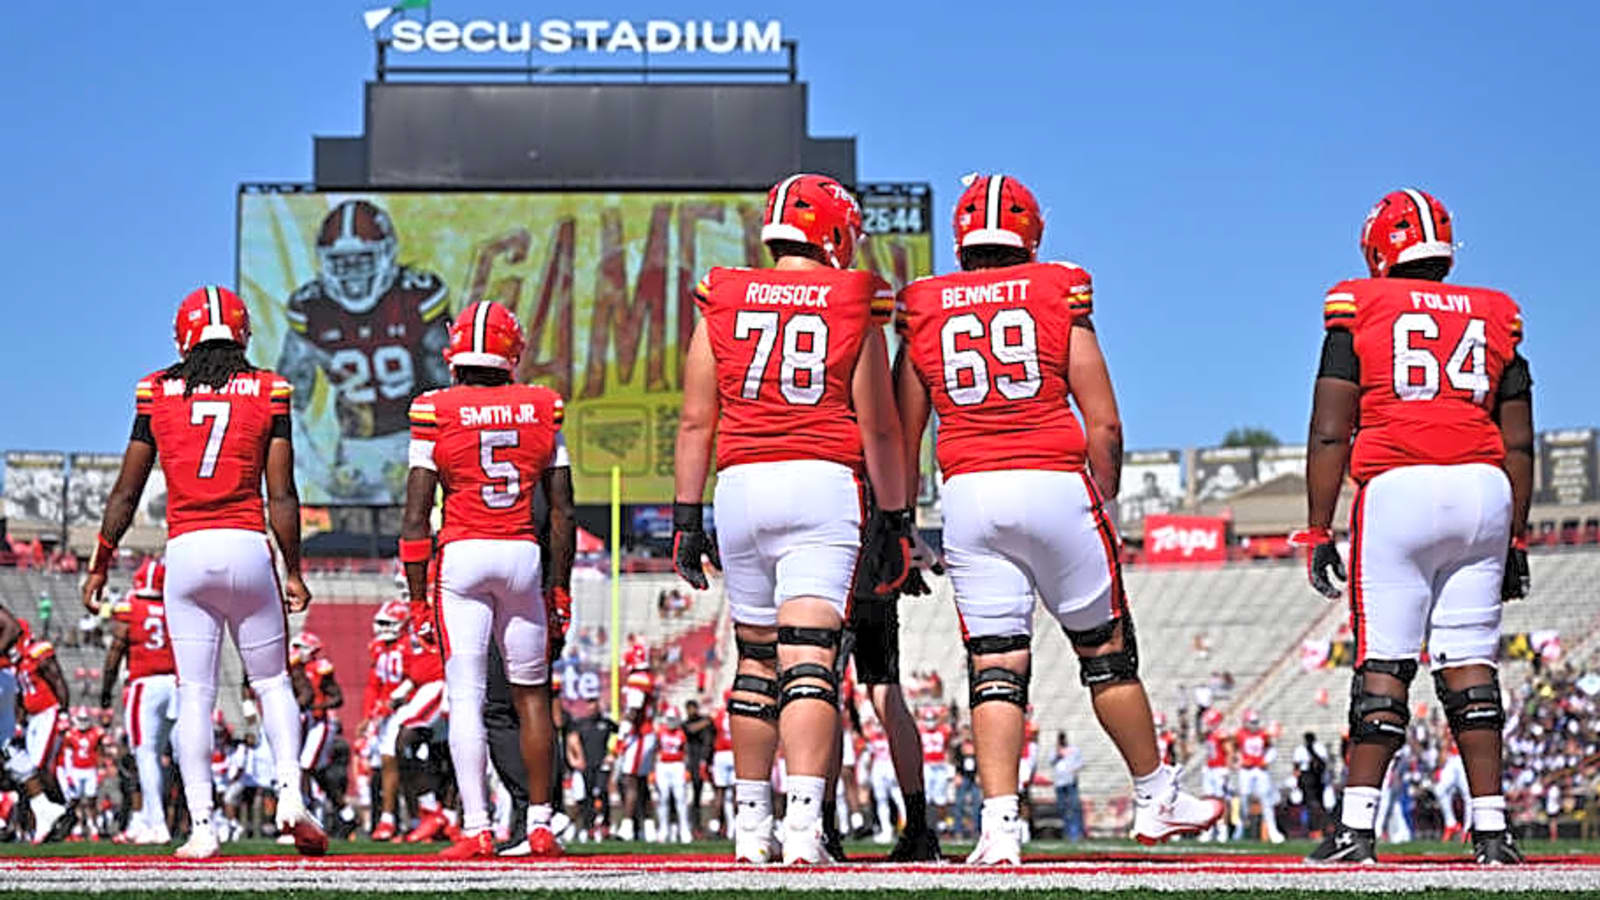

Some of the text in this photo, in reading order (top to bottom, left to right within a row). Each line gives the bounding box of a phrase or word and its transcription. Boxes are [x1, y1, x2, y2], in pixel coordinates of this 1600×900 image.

[539, 19, 782, 54] STADIUM
[745, 281, 831, 308] ROBSOCK
[941, 279, 1030, 310] BENNETT
[1410, 290, 1472, 314] FOLIVI
[330, 345, 415, 403] 29
[734, 310, 829, 406] 78
[940, 307, 1043, 406] 69
[1392, 312, 1490, 405] 64
[190, 400, 232, 479] 7
[460, 404, 539, 426] SMITH JR.
[479, 430, 520, 509] 5
